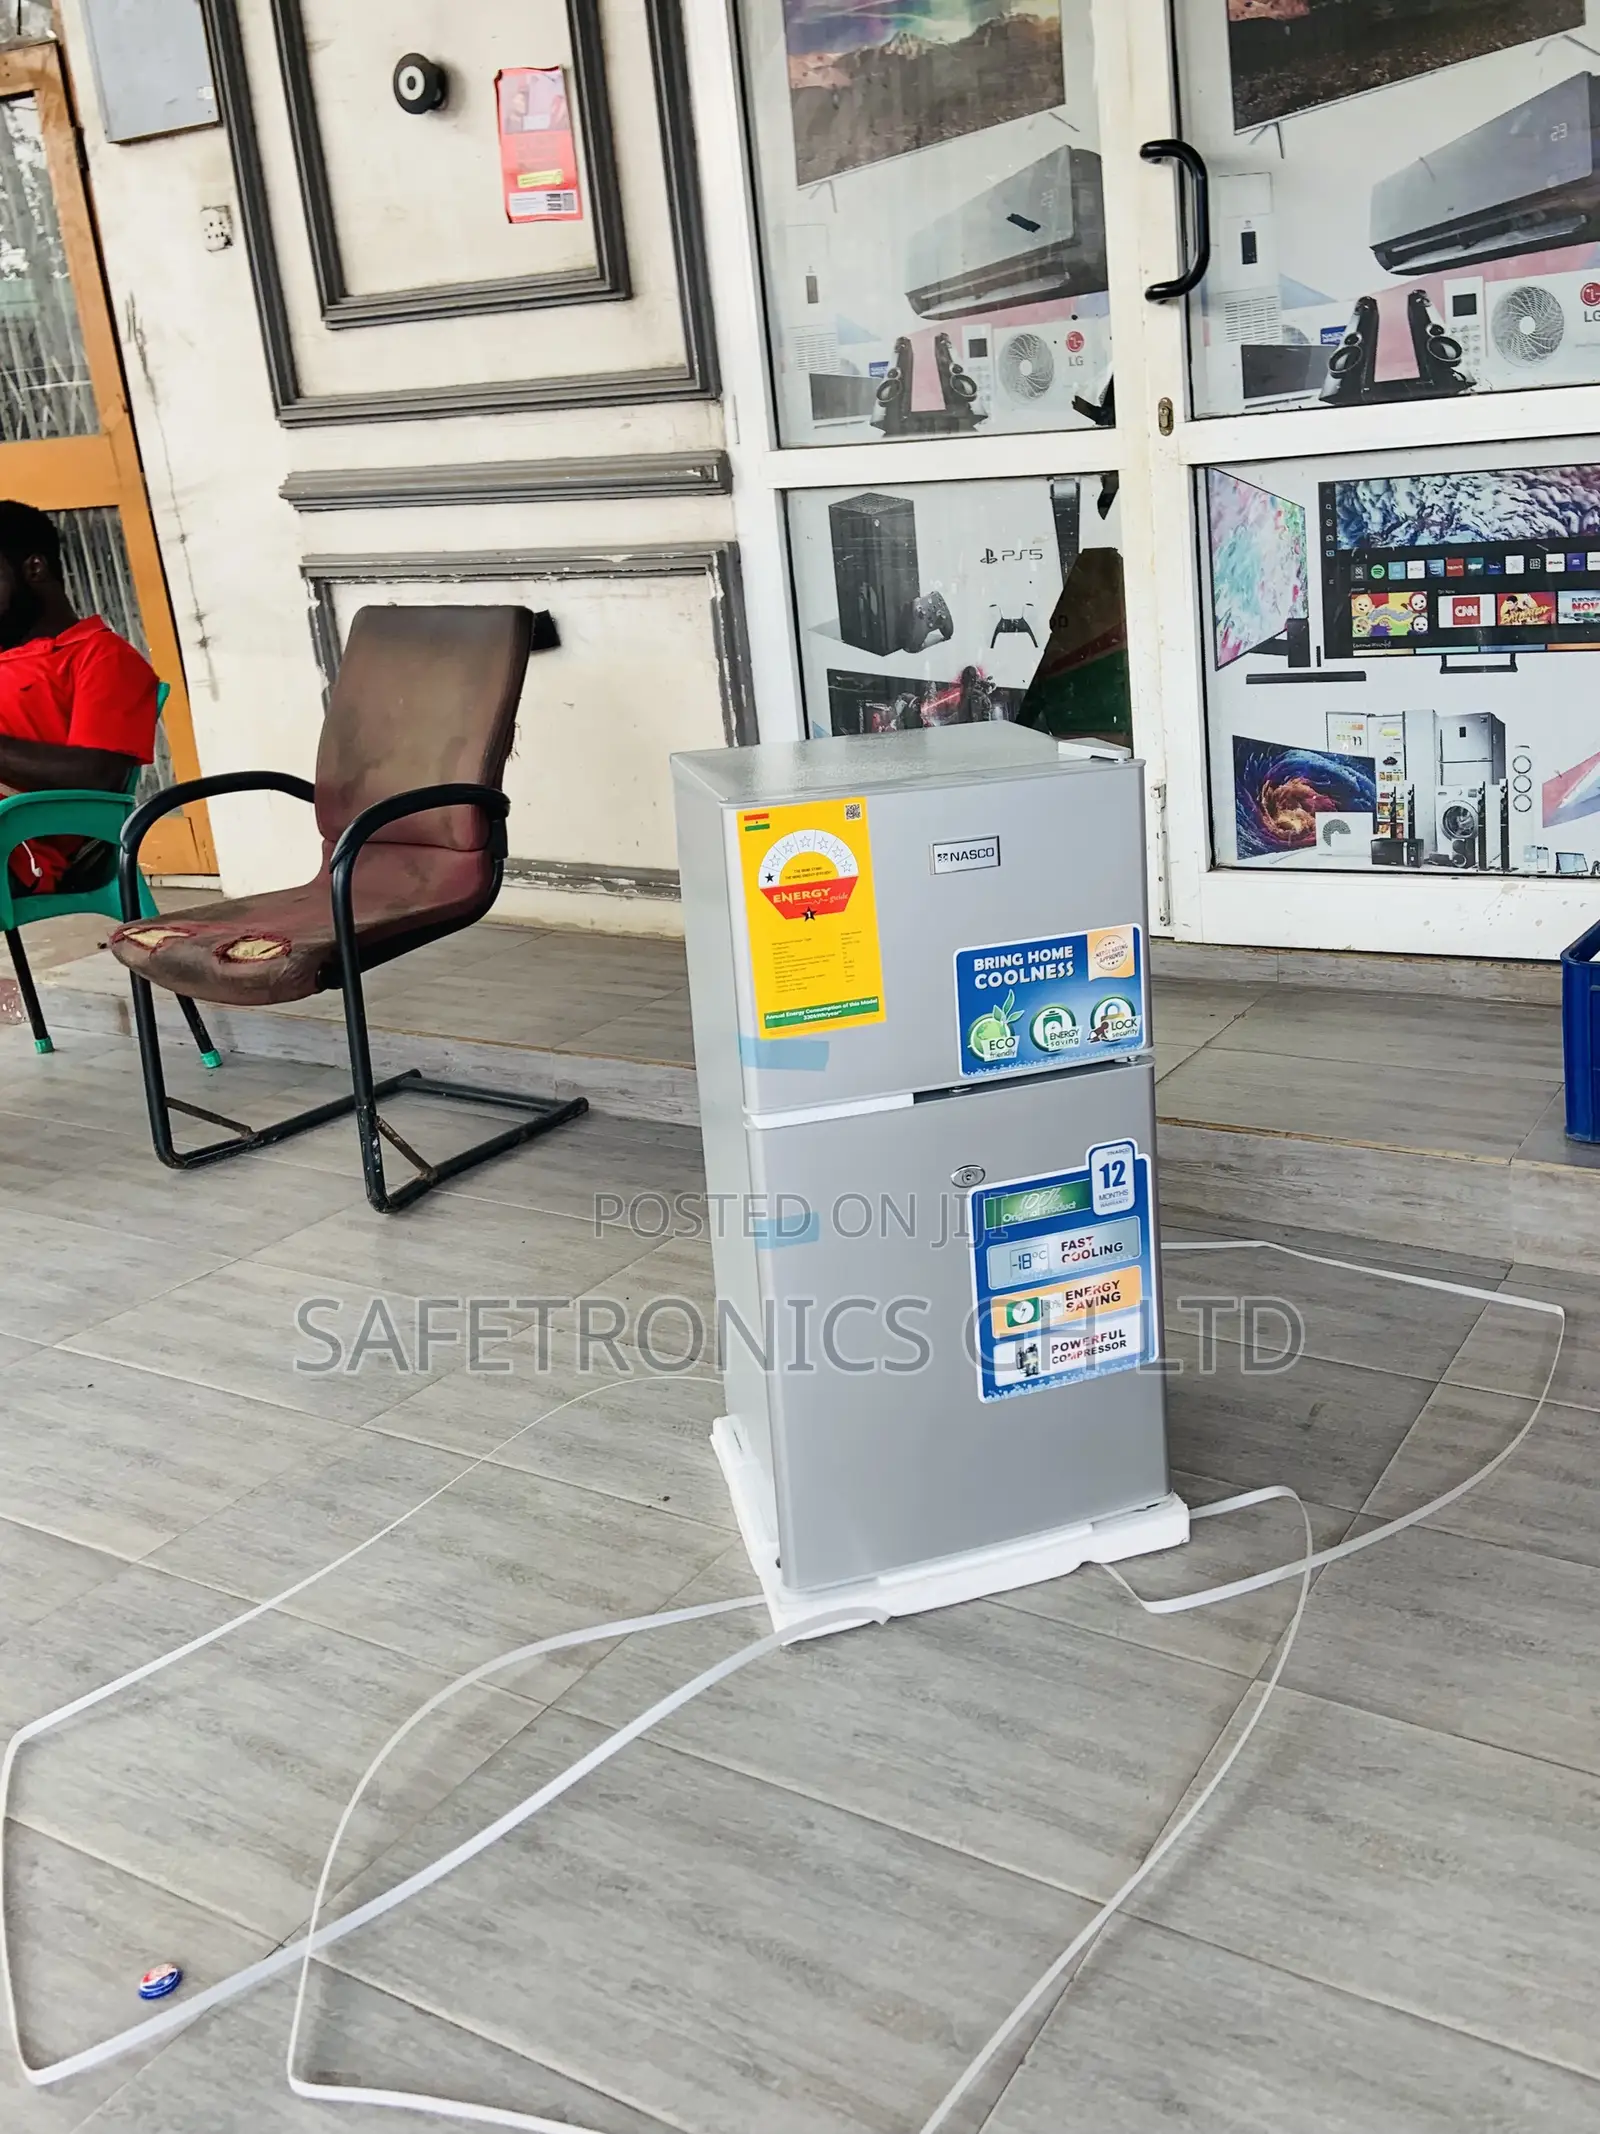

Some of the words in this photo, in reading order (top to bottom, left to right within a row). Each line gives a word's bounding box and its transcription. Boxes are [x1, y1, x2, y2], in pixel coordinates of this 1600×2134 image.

[1069, 356, 1084, 367] LG
[1001, 548, 1043, 561] PS5
[1455, 604, 1479, 618] CNN
[950, 847, 995, 862] NASCO
[772, 887, 831, 905] ENERGY
[974, 955, 1024, 972] BRING
[1028, 946, 1074, 964] HOME
[974, 961, 1075, 990] COOLNESS
[1111, 1018, 1138, 1031] LOCK
[1050, 1029, 1080, 1041] ENERGY
[1051, 1037, 1080, 1047] saving
[989, 1038, 1016, 1051] ECO
[1099, 1160, 1126, 1189] 12
[1099, 1189, 1129, 1201] MONTHS
[1003, 1209, 1040, 1223] Original
[1043, 1201, 1077, 1215] Product
[1061, 1236, 1094, 1252] FAST
[1062, 1242, 1124, 1264] COOLING
[1065, 1280, 1121, 1302] ENERGY
[1065, 1291, 1122, 1313] SAVING
[1051, 1329, 1127, 1355] POWERFUL
[1051, 1339, 1128, 1365] COMPRESSOR
